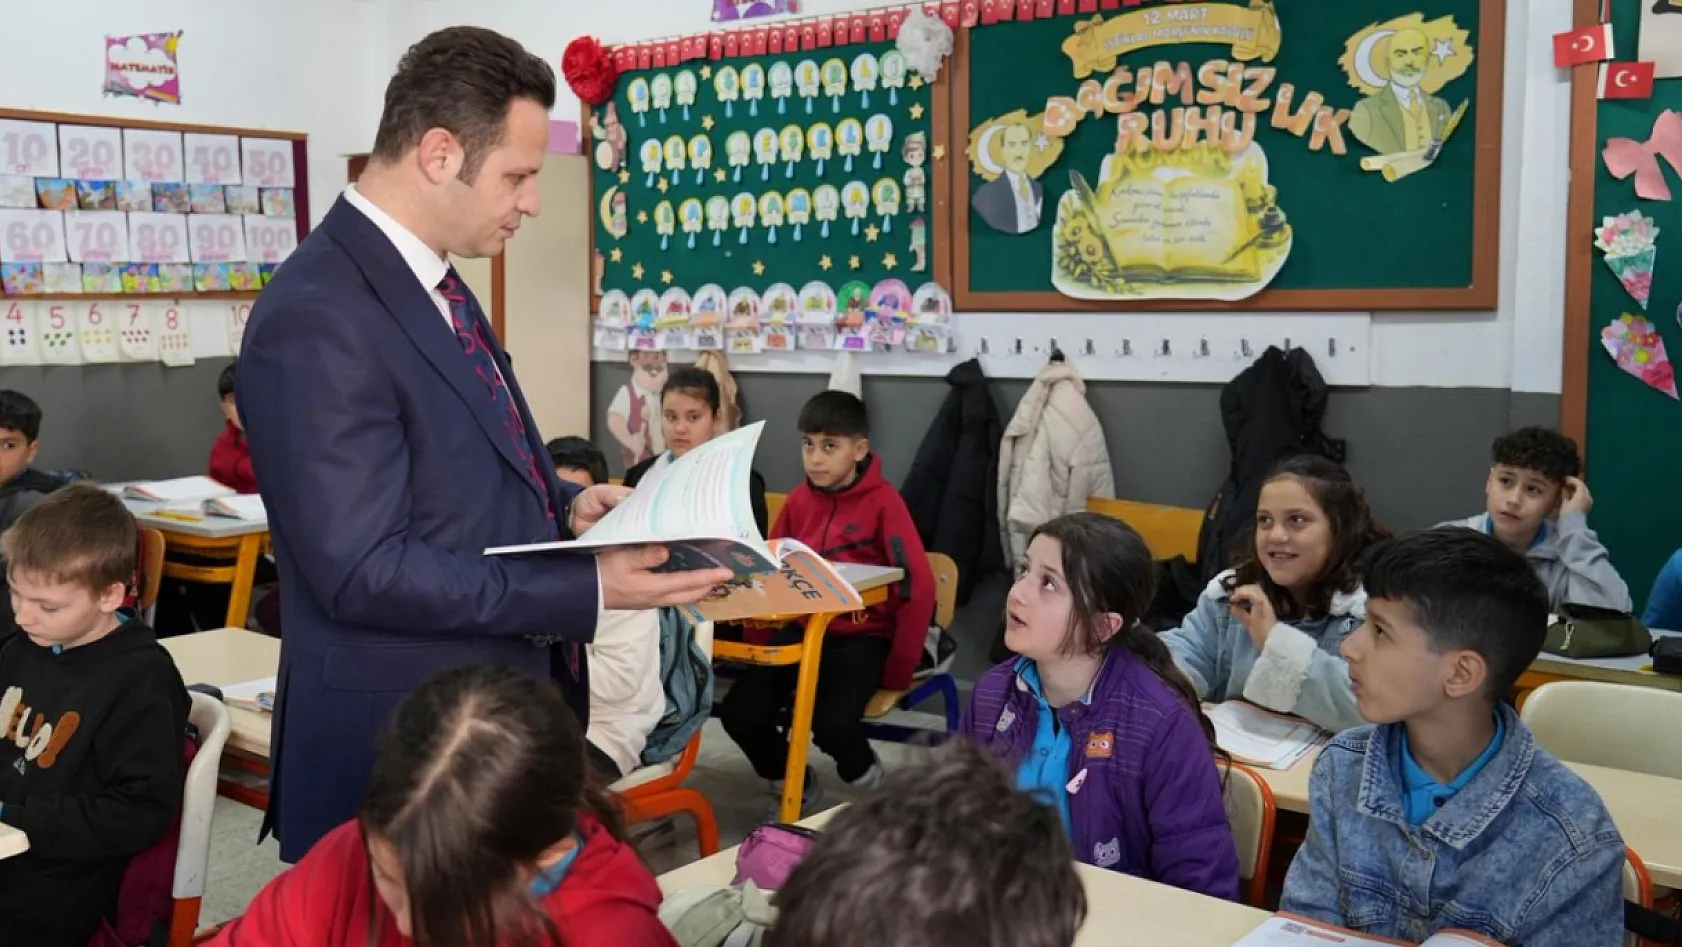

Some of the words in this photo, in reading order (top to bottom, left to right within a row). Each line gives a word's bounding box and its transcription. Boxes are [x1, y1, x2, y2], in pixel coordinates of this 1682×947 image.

[1143, 10, 1161, 25] 12
[1166, 7, 1208, 22] MART
[1115, 104, 1257, 155] RUHU
[3, 132, 47, 166] 10
[68, 138, 115, 168] 20
[132, 142, 175, 171] 30
[193, 145, 231, 175] 40
[249, 149, 286, 177] 50
[6, 221, 55, 251] 60
[75, 222, 117, 255] 70
[137, 224, 179, 250] 80
[197, 224, 236, 249] 90
[249, 226, 291, 249] 100
[6, 301, 22, 324] 4
[49, 305, 66, 330] 5
[89, 302, 102, 325] 6
[126, 304, 140, 327] 7
[165, 308, 178, 330] 8
